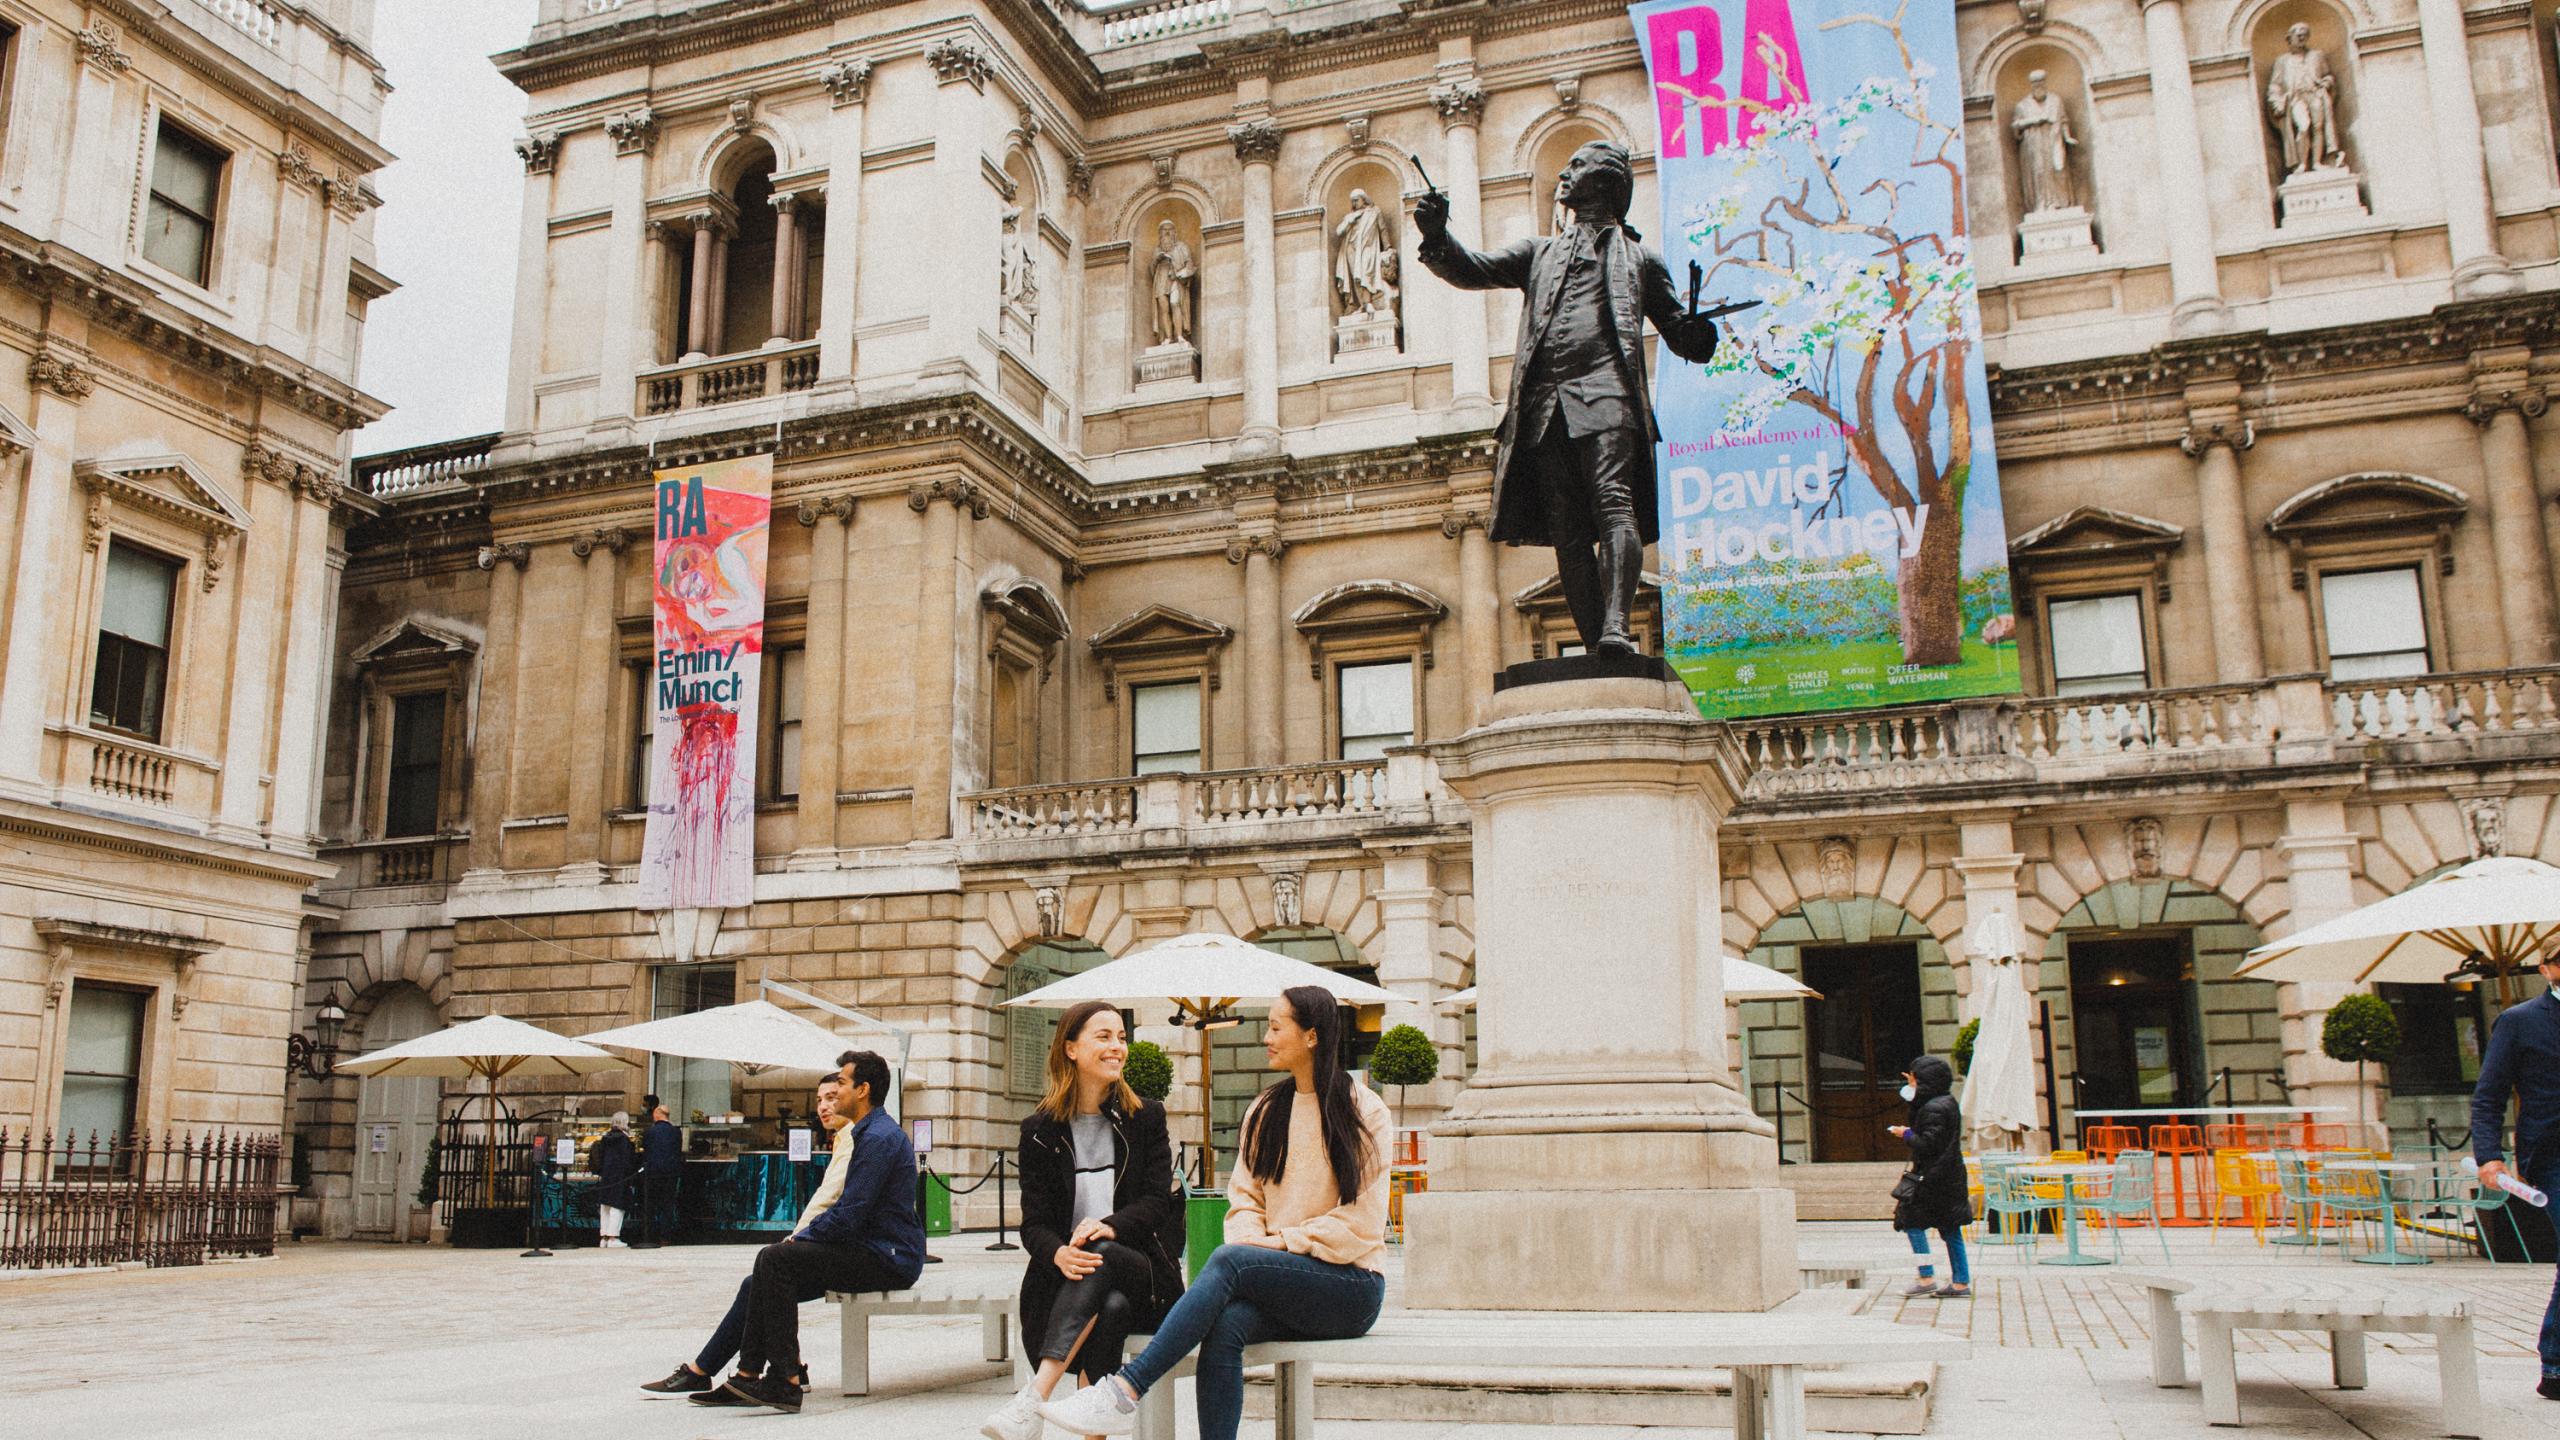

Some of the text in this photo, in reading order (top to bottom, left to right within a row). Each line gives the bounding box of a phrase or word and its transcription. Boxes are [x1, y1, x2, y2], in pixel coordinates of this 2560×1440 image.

[1647, 0, 1818, 158] RA
[1668, 434, 1714, 460] Royal
[1717, 427, 1802, 450] Academy
[1803, 424, 1821, 441] of
[1669, 451, 1830, 519] David
[658, 476, 707, 541] RA
[1672, 504, 1930, 573] Hockney
[659, 640, 740, 680] Emin/
[1788, 670, 1829, 680] CHARLES
[1887, 664, 1920, 676] OFFER
[1887, 671, 1949, 686] WATERMAN
[1788, 678, 1829, 690] STANLEY
